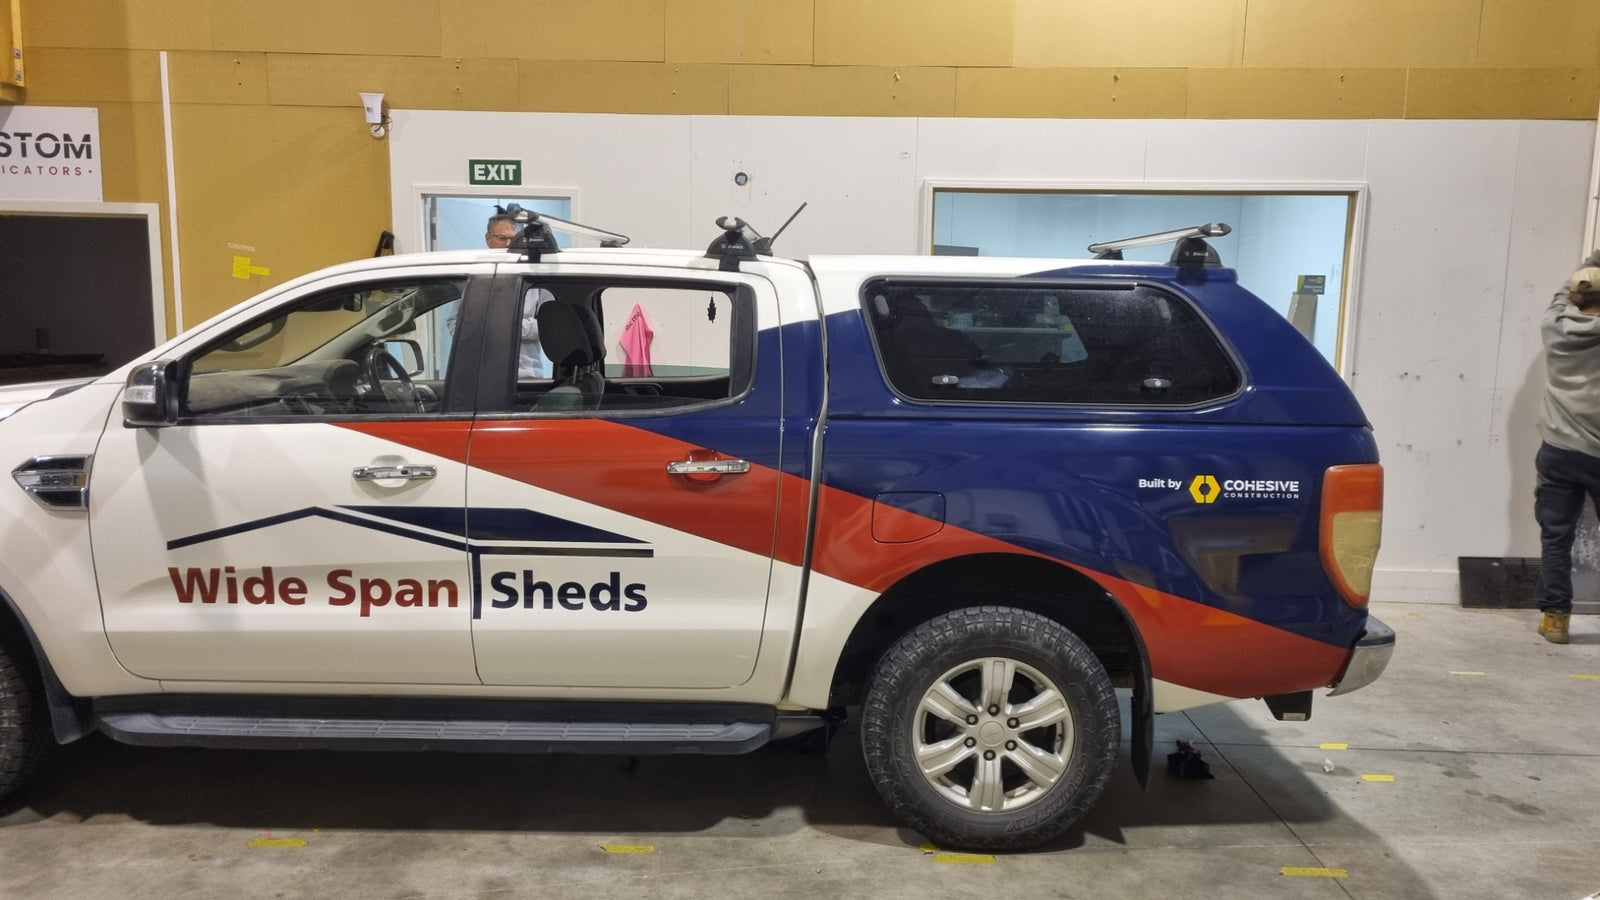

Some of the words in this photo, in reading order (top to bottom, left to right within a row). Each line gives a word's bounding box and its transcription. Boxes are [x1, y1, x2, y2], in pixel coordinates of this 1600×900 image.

[474, 164, 517, 181] EXIT
[1138, 478, 1166, 488] Built
[1168, 478, 1182, 490] by
[1224, 480, 1299, 492] COHESIVE
[168, 566, 308, 606] Wide
[326, 569, 459, 617] Span
[490, 570, 648, 612] Sheds
